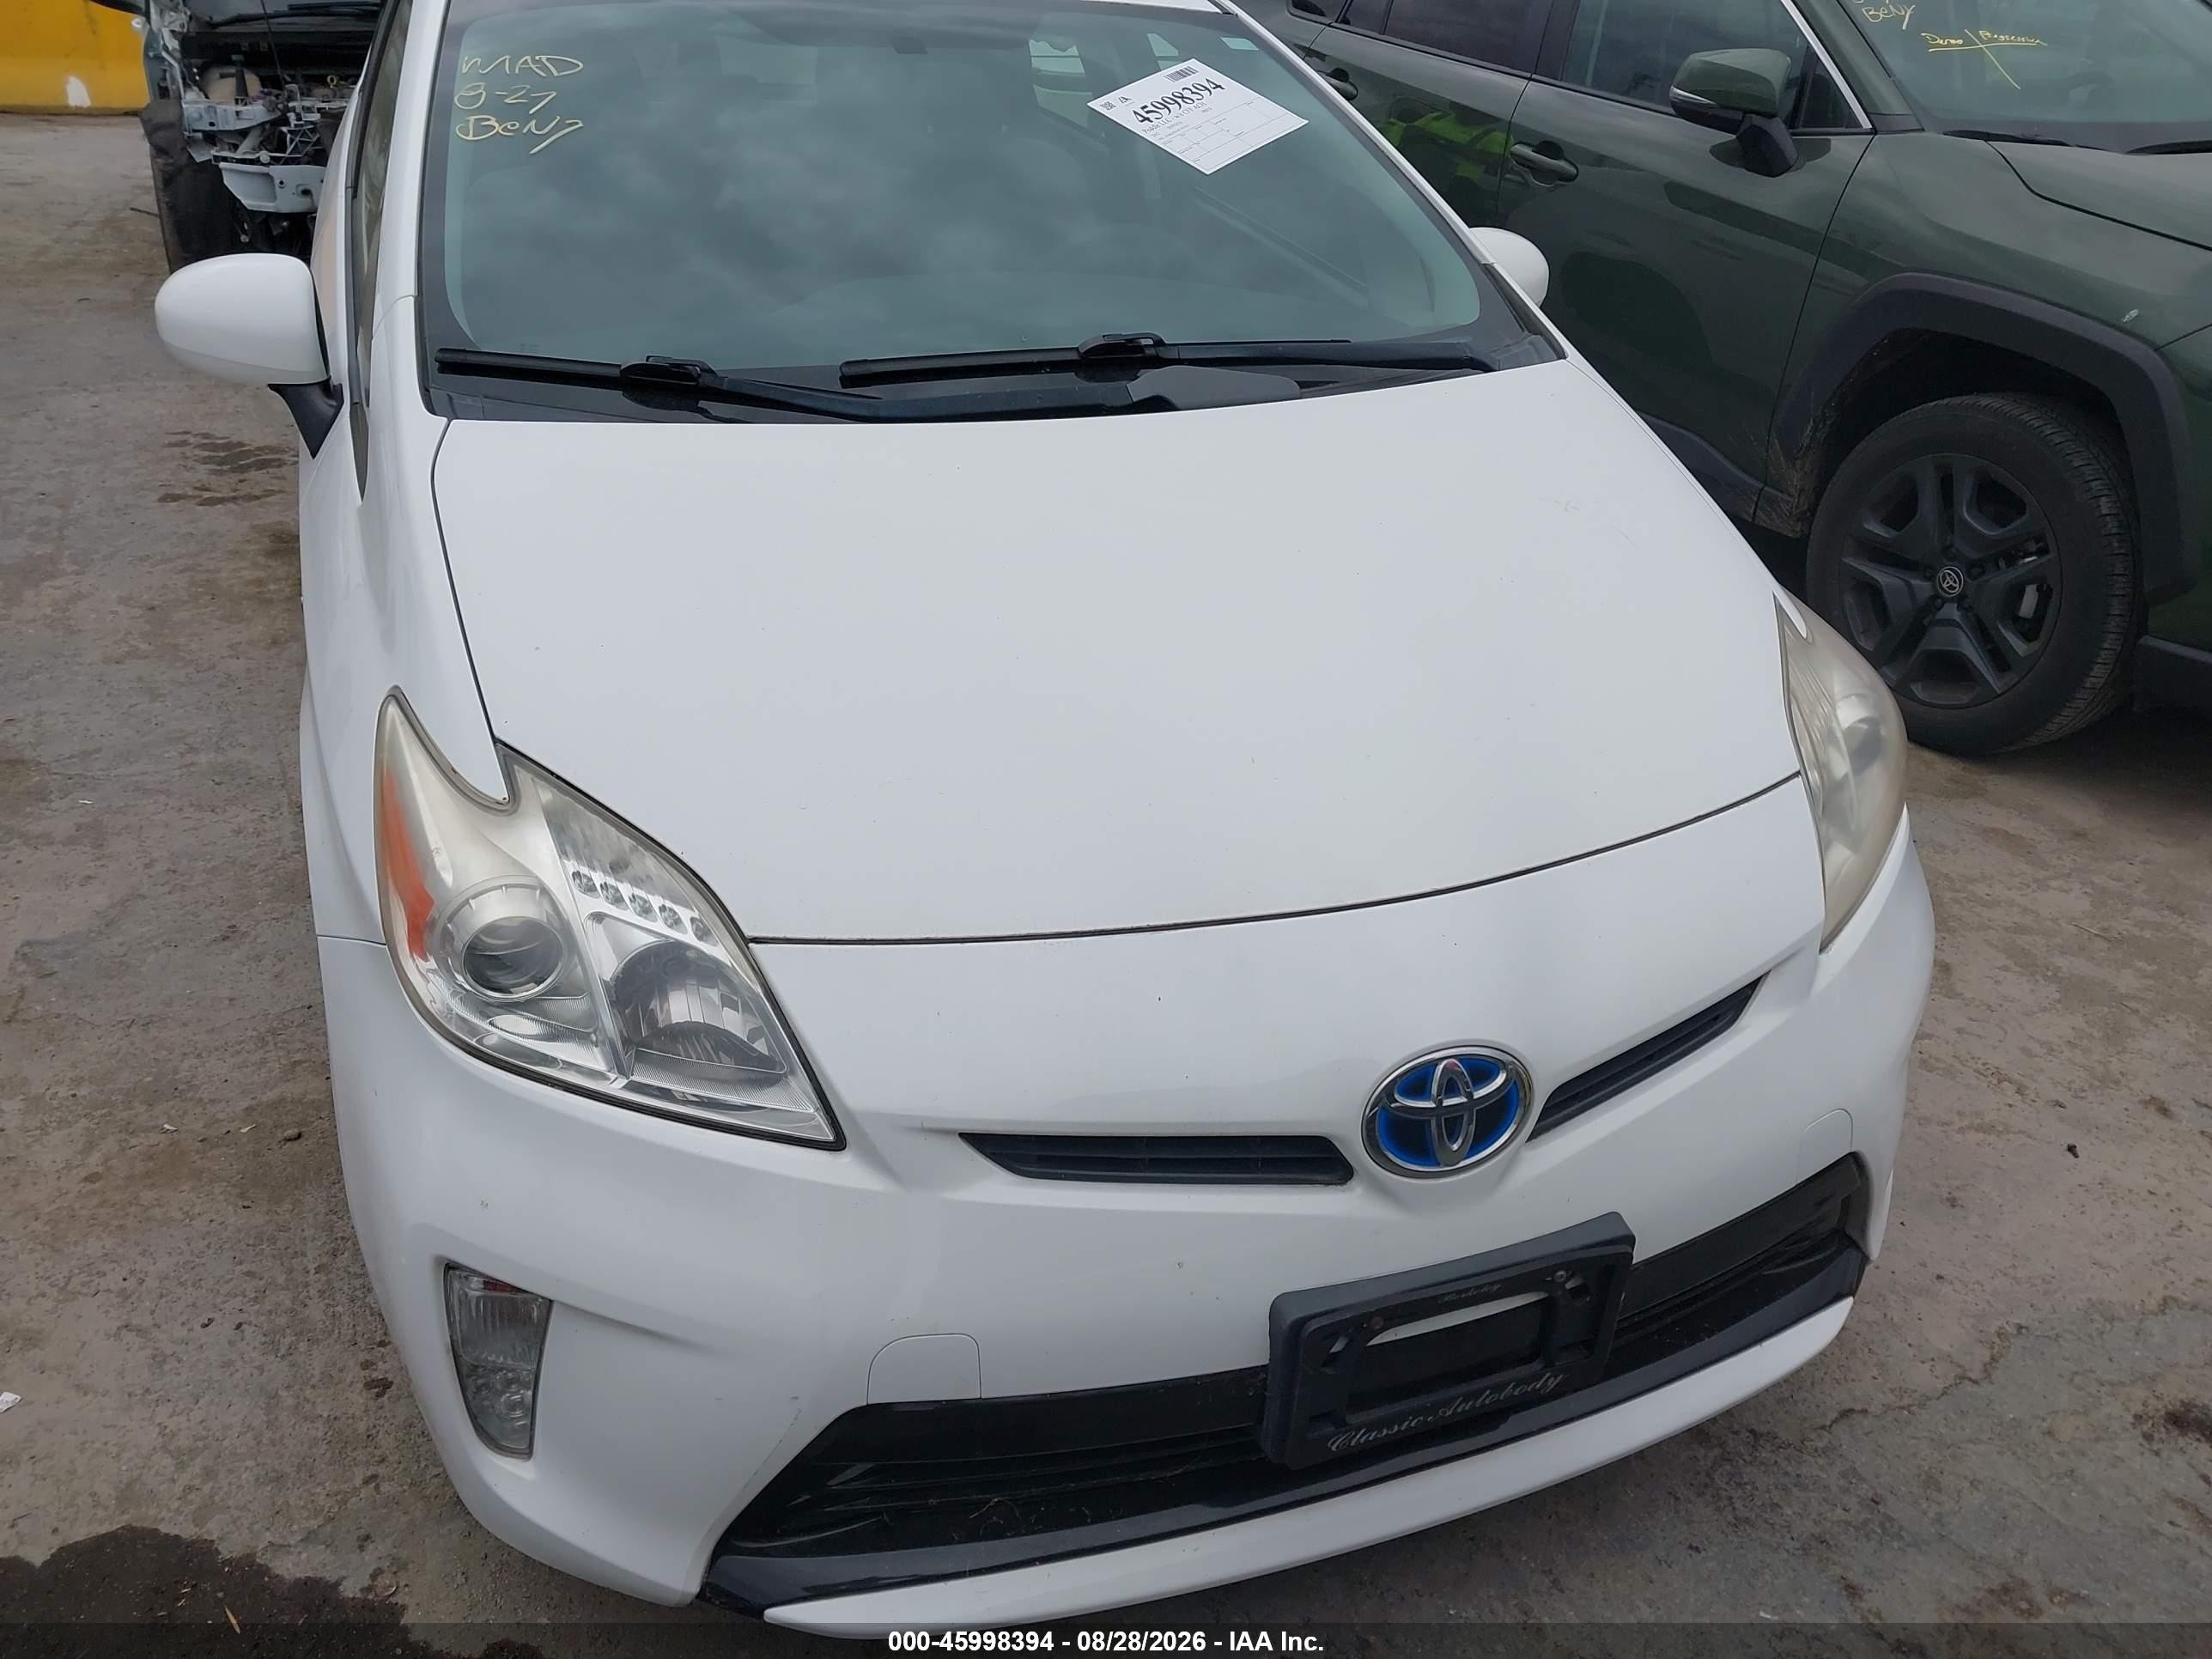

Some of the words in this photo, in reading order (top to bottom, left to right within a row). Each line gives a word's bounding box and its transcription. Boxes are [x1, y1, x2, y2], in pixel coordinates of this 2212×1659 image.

[1132, 78, 1225, 123] 45998394
[1328, 1413, 1424, 1452] Classic
[1426, 1372, 1565, 1421] Autobody
